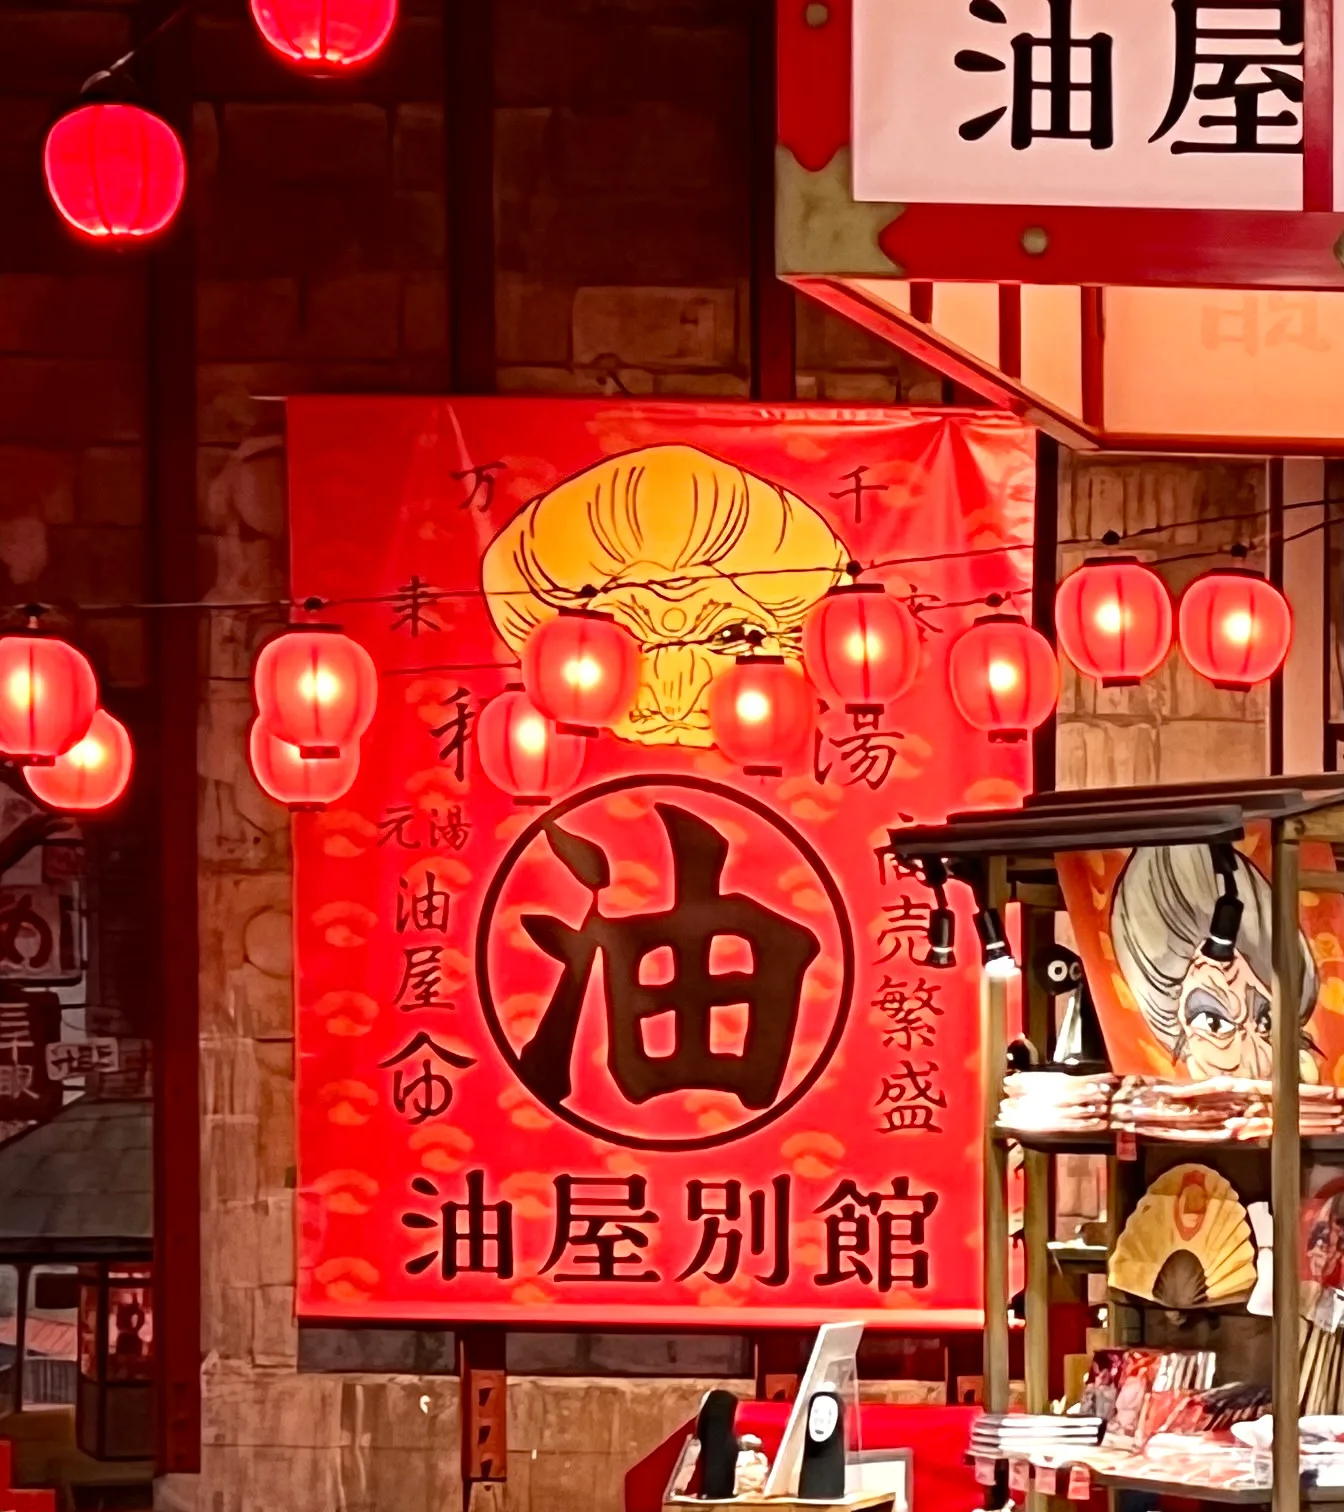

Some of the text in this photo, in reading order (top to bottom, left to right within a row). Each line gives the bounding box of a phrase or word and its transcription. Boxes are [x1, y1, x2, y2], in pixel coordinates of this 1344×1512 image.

[813, 698, 904, 790] 湯
[393, 870, 455, 1012] 油屋
[520, 803, 821, 1109] 油
[401, 1168, 939, 1291] 油屋別館
